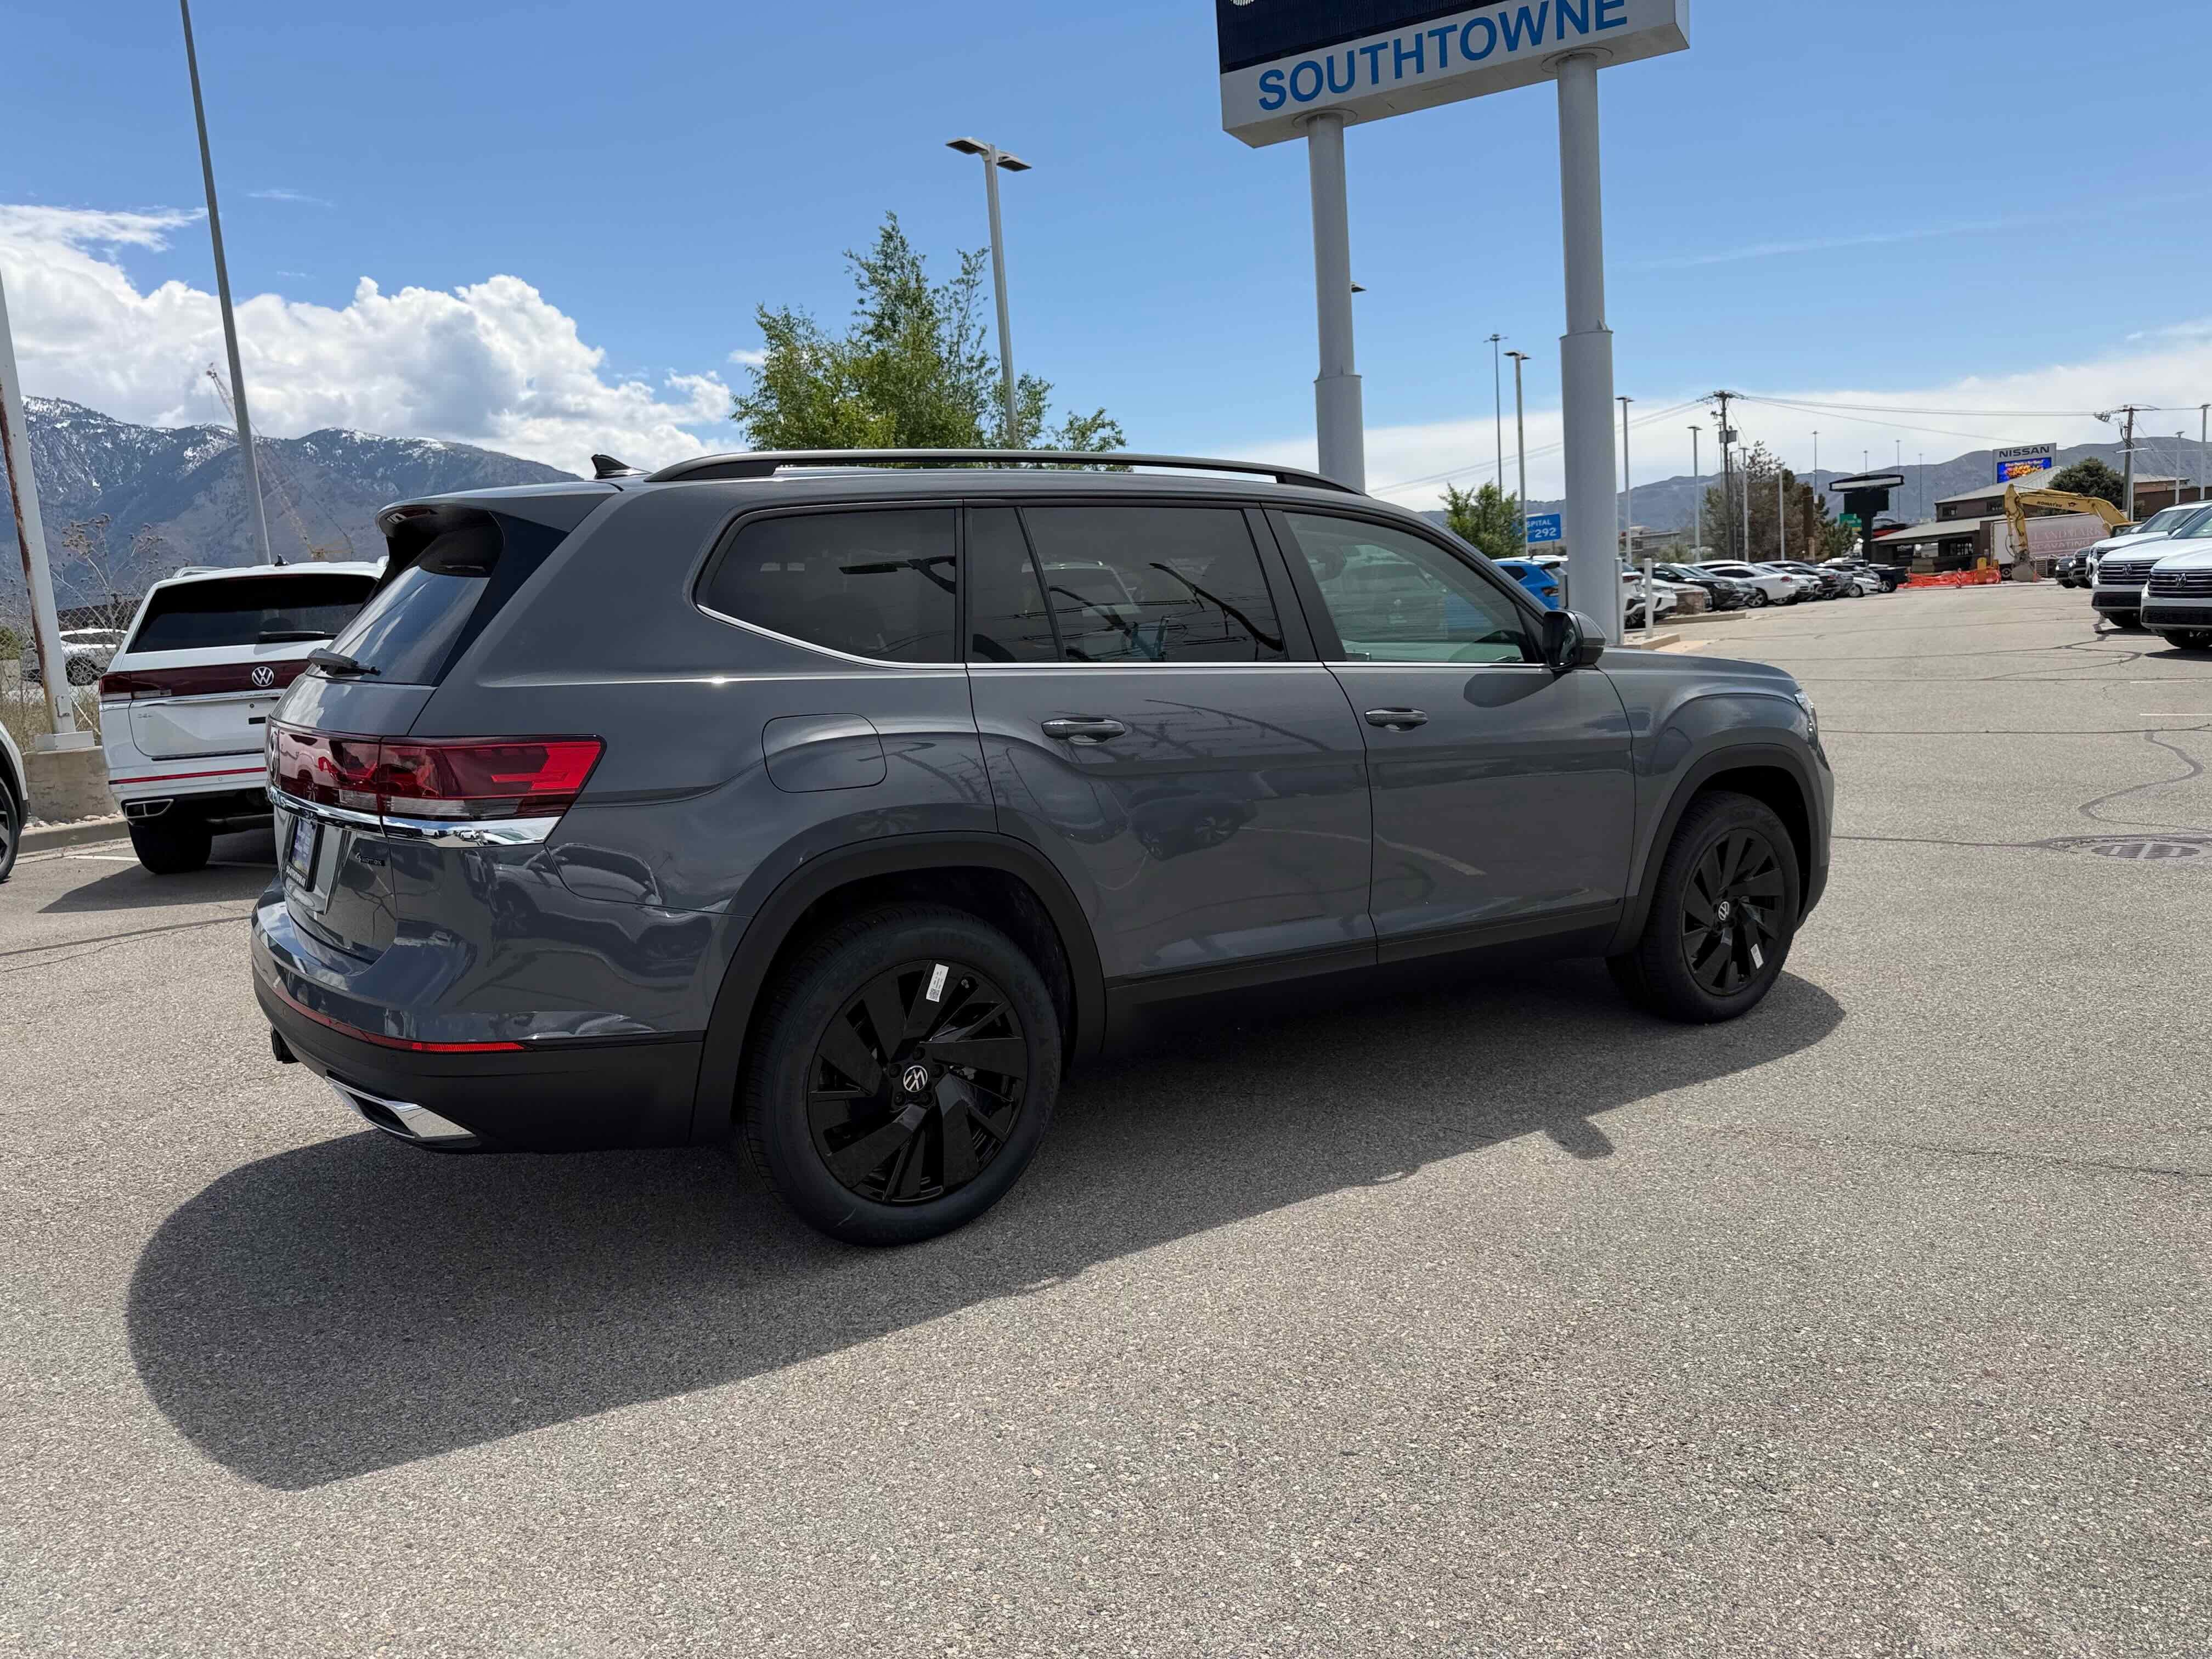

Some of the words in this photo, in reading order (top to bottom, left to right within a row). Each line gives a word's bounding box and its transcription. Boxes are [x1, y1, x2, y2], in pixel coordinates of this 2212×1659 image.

[1258, 0, 1628, 111] SOUTHTOWNE
[1999, 445, 2050, 458] NISSAN
[1527, 519, 1553, 527] SPITAL
[1534, 527, 1557, 538] 292
[252, 666, 274, 686] VW
